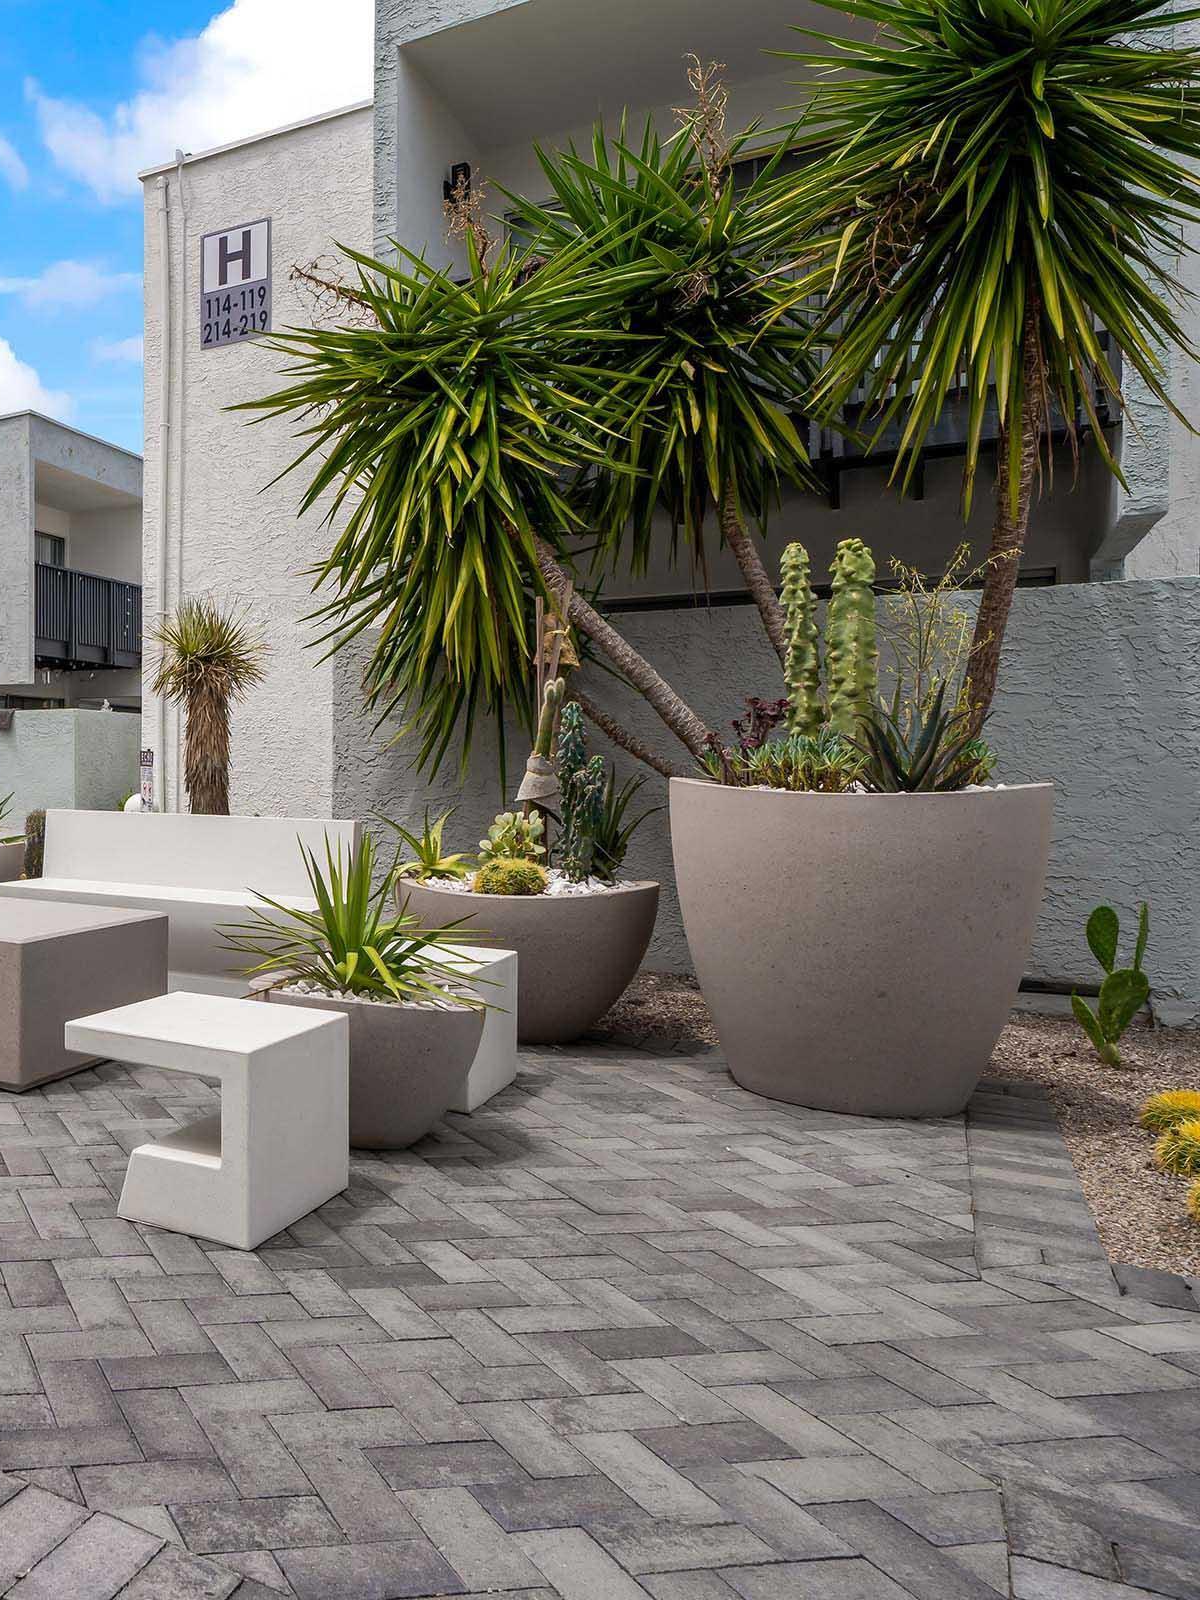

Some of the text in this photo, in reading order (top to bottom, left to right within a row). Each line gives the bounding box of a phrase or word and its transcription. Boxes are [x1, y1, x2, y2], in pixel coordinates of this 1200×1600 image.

[218, 229, 251, 286] H
[206, 286, 266, 319] 114-119
[203, 310, 268, 344] 214-219
